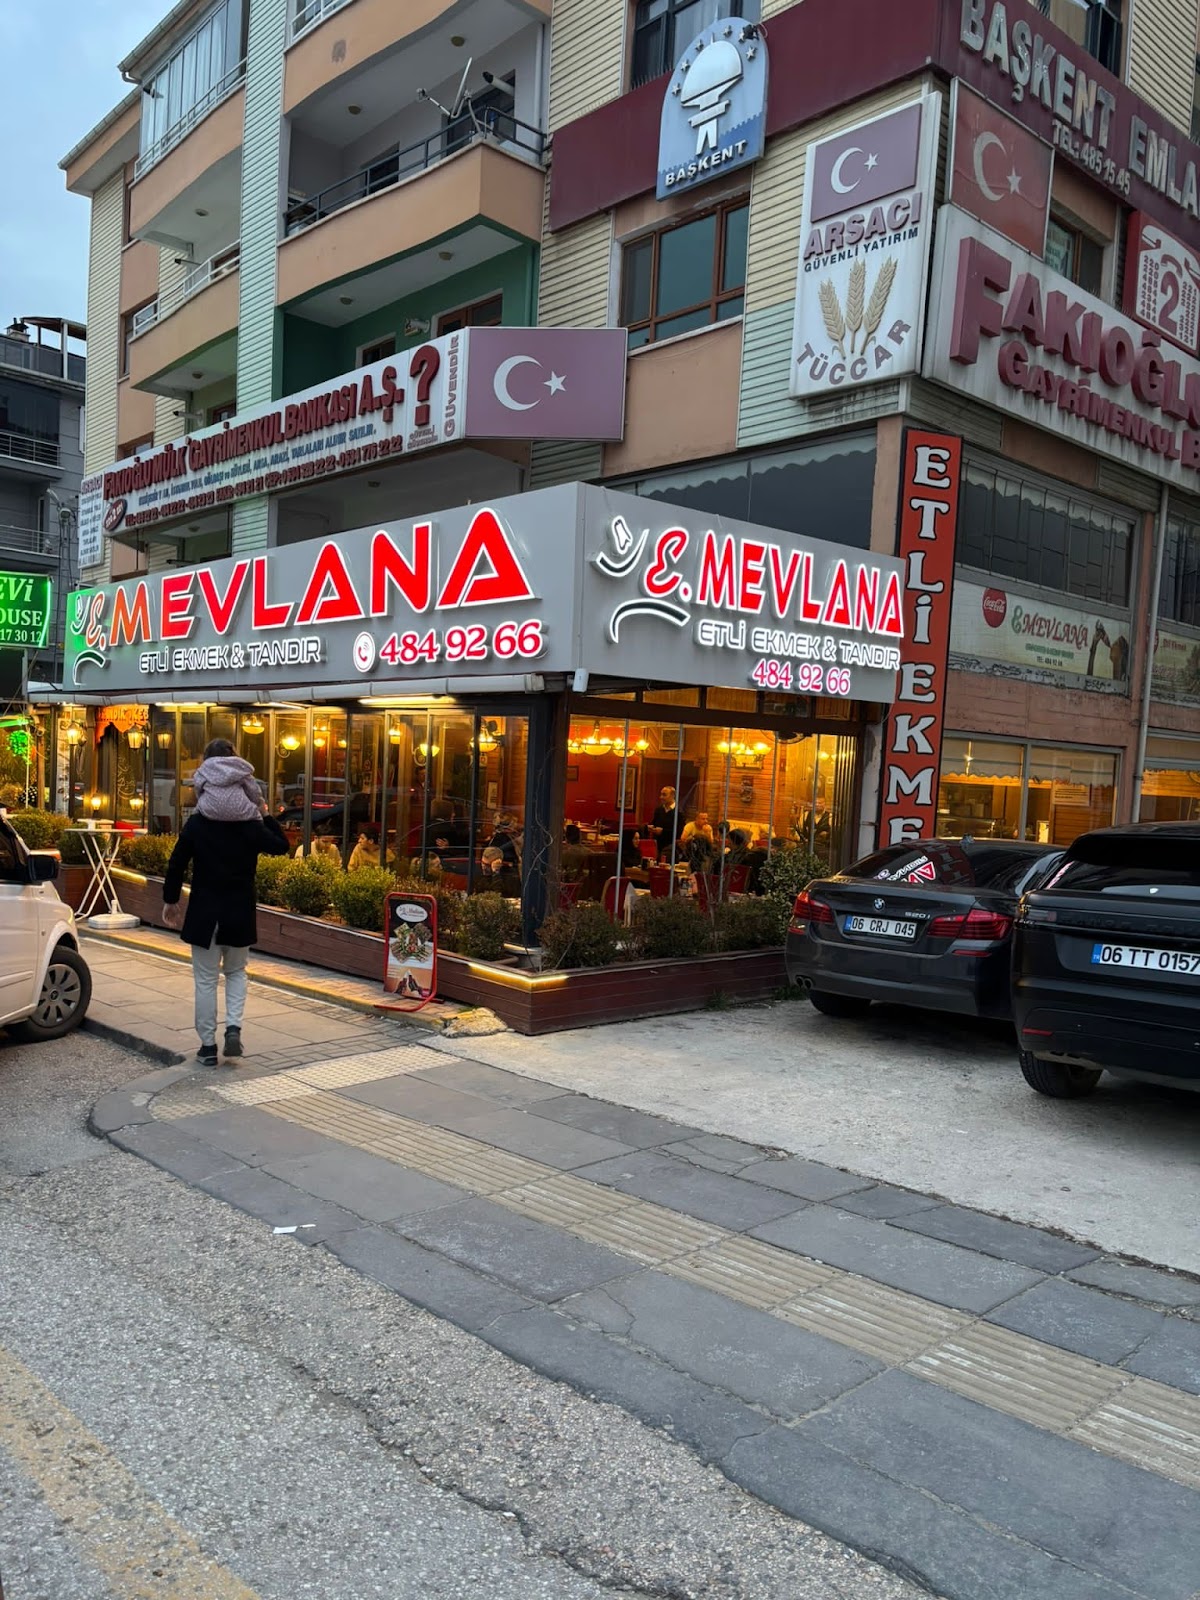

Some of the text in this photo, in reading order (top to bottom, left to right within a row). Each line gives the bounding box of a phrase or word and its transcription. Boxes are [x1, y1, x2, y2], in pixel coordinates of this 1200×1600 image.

[960, 0, 1115, 149] BAŞKENT
[665, 139, 747, 188] BAŞKENT
[1080, 142, 1103, 175] 485
[1116, 168, 1131, 195] 45
[803, 192, 923, 261] ARSACI
[804, 227, 919, 273] GÜVENLİ YATIRIM
[796, 319, 912, 385] TÜCCAR
[410, 345, 440, 427] ?
[444, 335, 459, 437] GÜVENDİR
[998, 340, 1180, 461] GAYRİMENKUL
[906, 445, 951, 644] ETLİ
[109, 507, 535, 646] MEVLANA
[697, 530, 904, 638] MEVLANA
[15, 630, 28, 642] 30
[139, 619, 542, 673] ETLİ EKMEK & TANDIR 484 92 66
[698, 620, 900, 671] ETLİ EKMEK & TANDIR
[1022, 612, 1089, 650] MEVLANA
[752, 658, 851, 696] 484 92 66
[852, 916, 915, 939] 06 CRJ 045
[1101, 946, 1200, 973] 06 TT 0157
